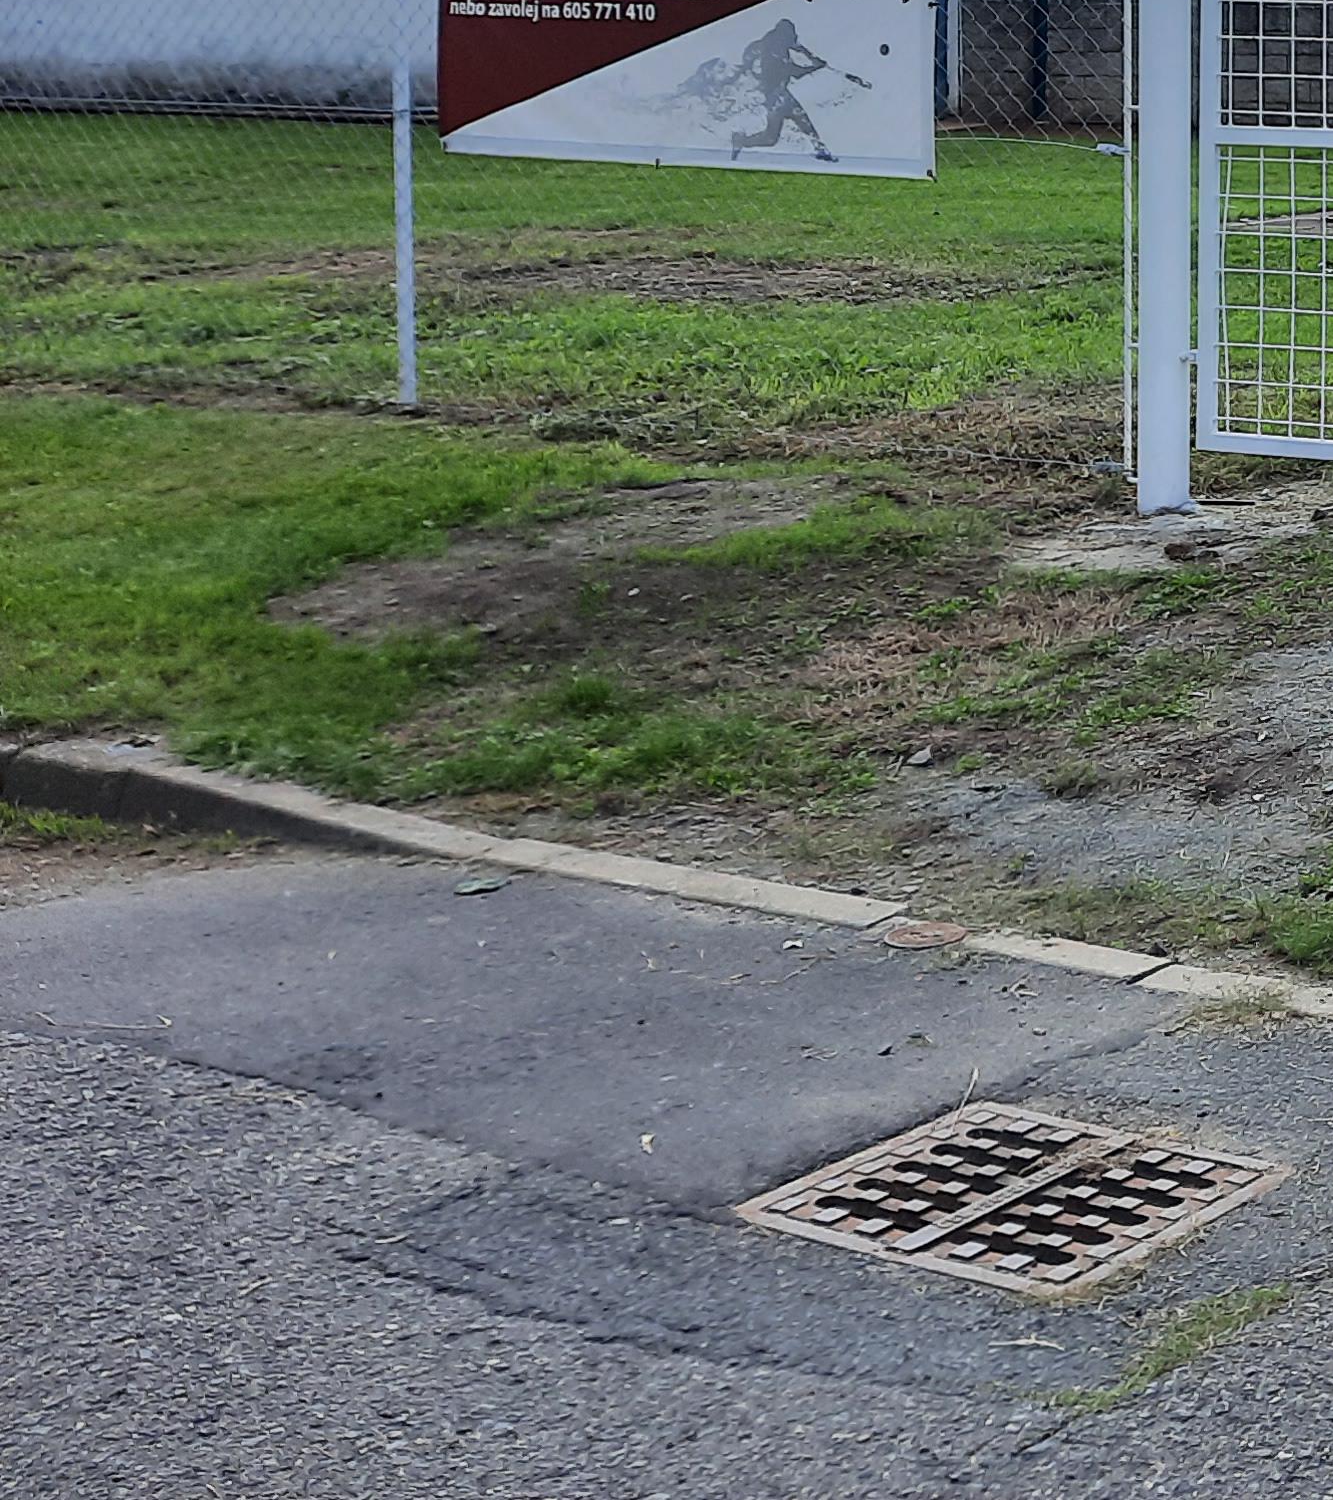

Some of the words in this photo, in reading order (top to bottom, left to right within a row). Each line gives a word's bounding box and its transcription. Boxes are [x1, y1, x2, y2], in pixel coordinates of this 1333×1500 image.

[450, 0, 485, 15] nebo
[488, 1, 539, 22] zavolej
[542, 4, 560, 18] na
[562, 2, 591, 19] 605
[595, 3, 621, 20] 771
[625, 3, 656, 21] 410
